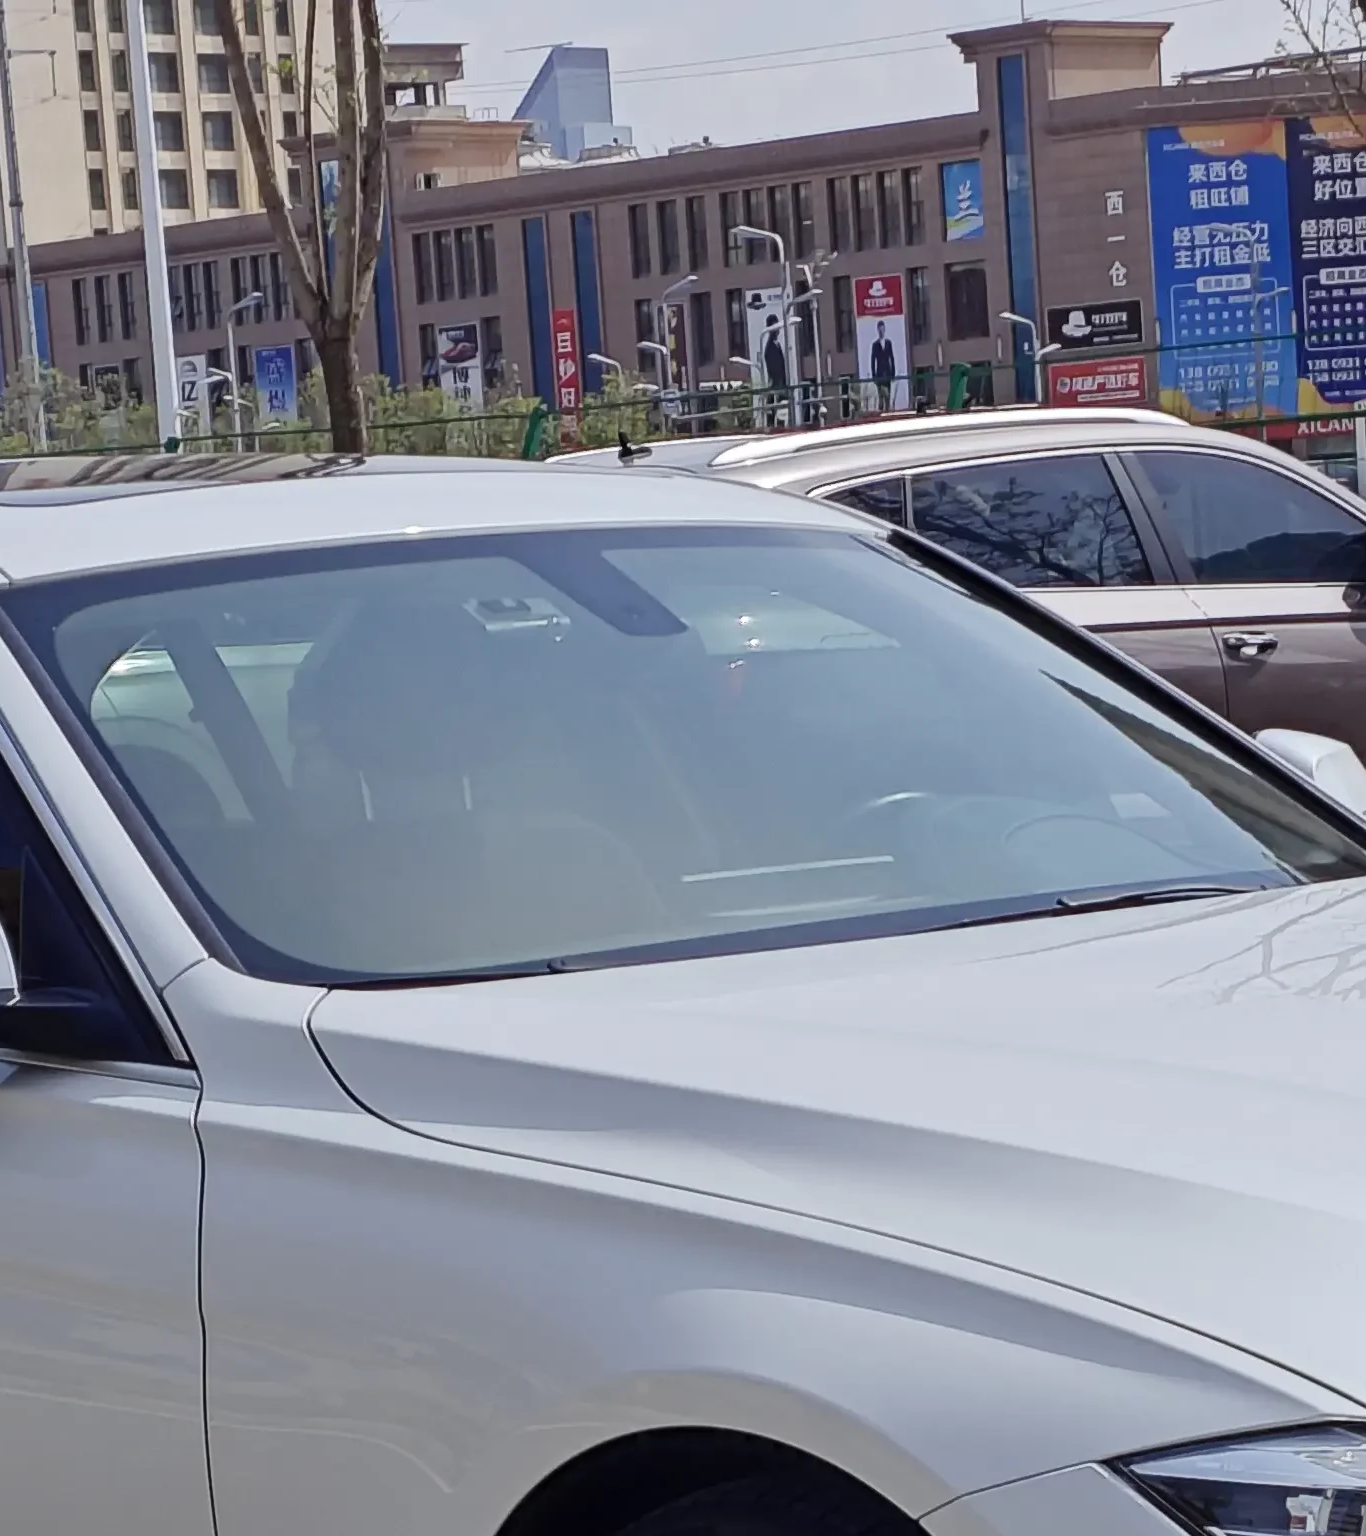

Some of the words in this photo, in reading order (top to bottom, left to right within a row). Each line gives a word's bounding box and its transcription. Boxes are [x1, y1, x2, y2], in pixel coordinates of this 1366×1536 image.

[1188, 159, 1248, 183] 来西仓
[1104, 190, 1127, 287] 西一仓
[1172, 220, 1269, 247] 经营无压力
[1173, 243, 1271, 269] 主打租金低
